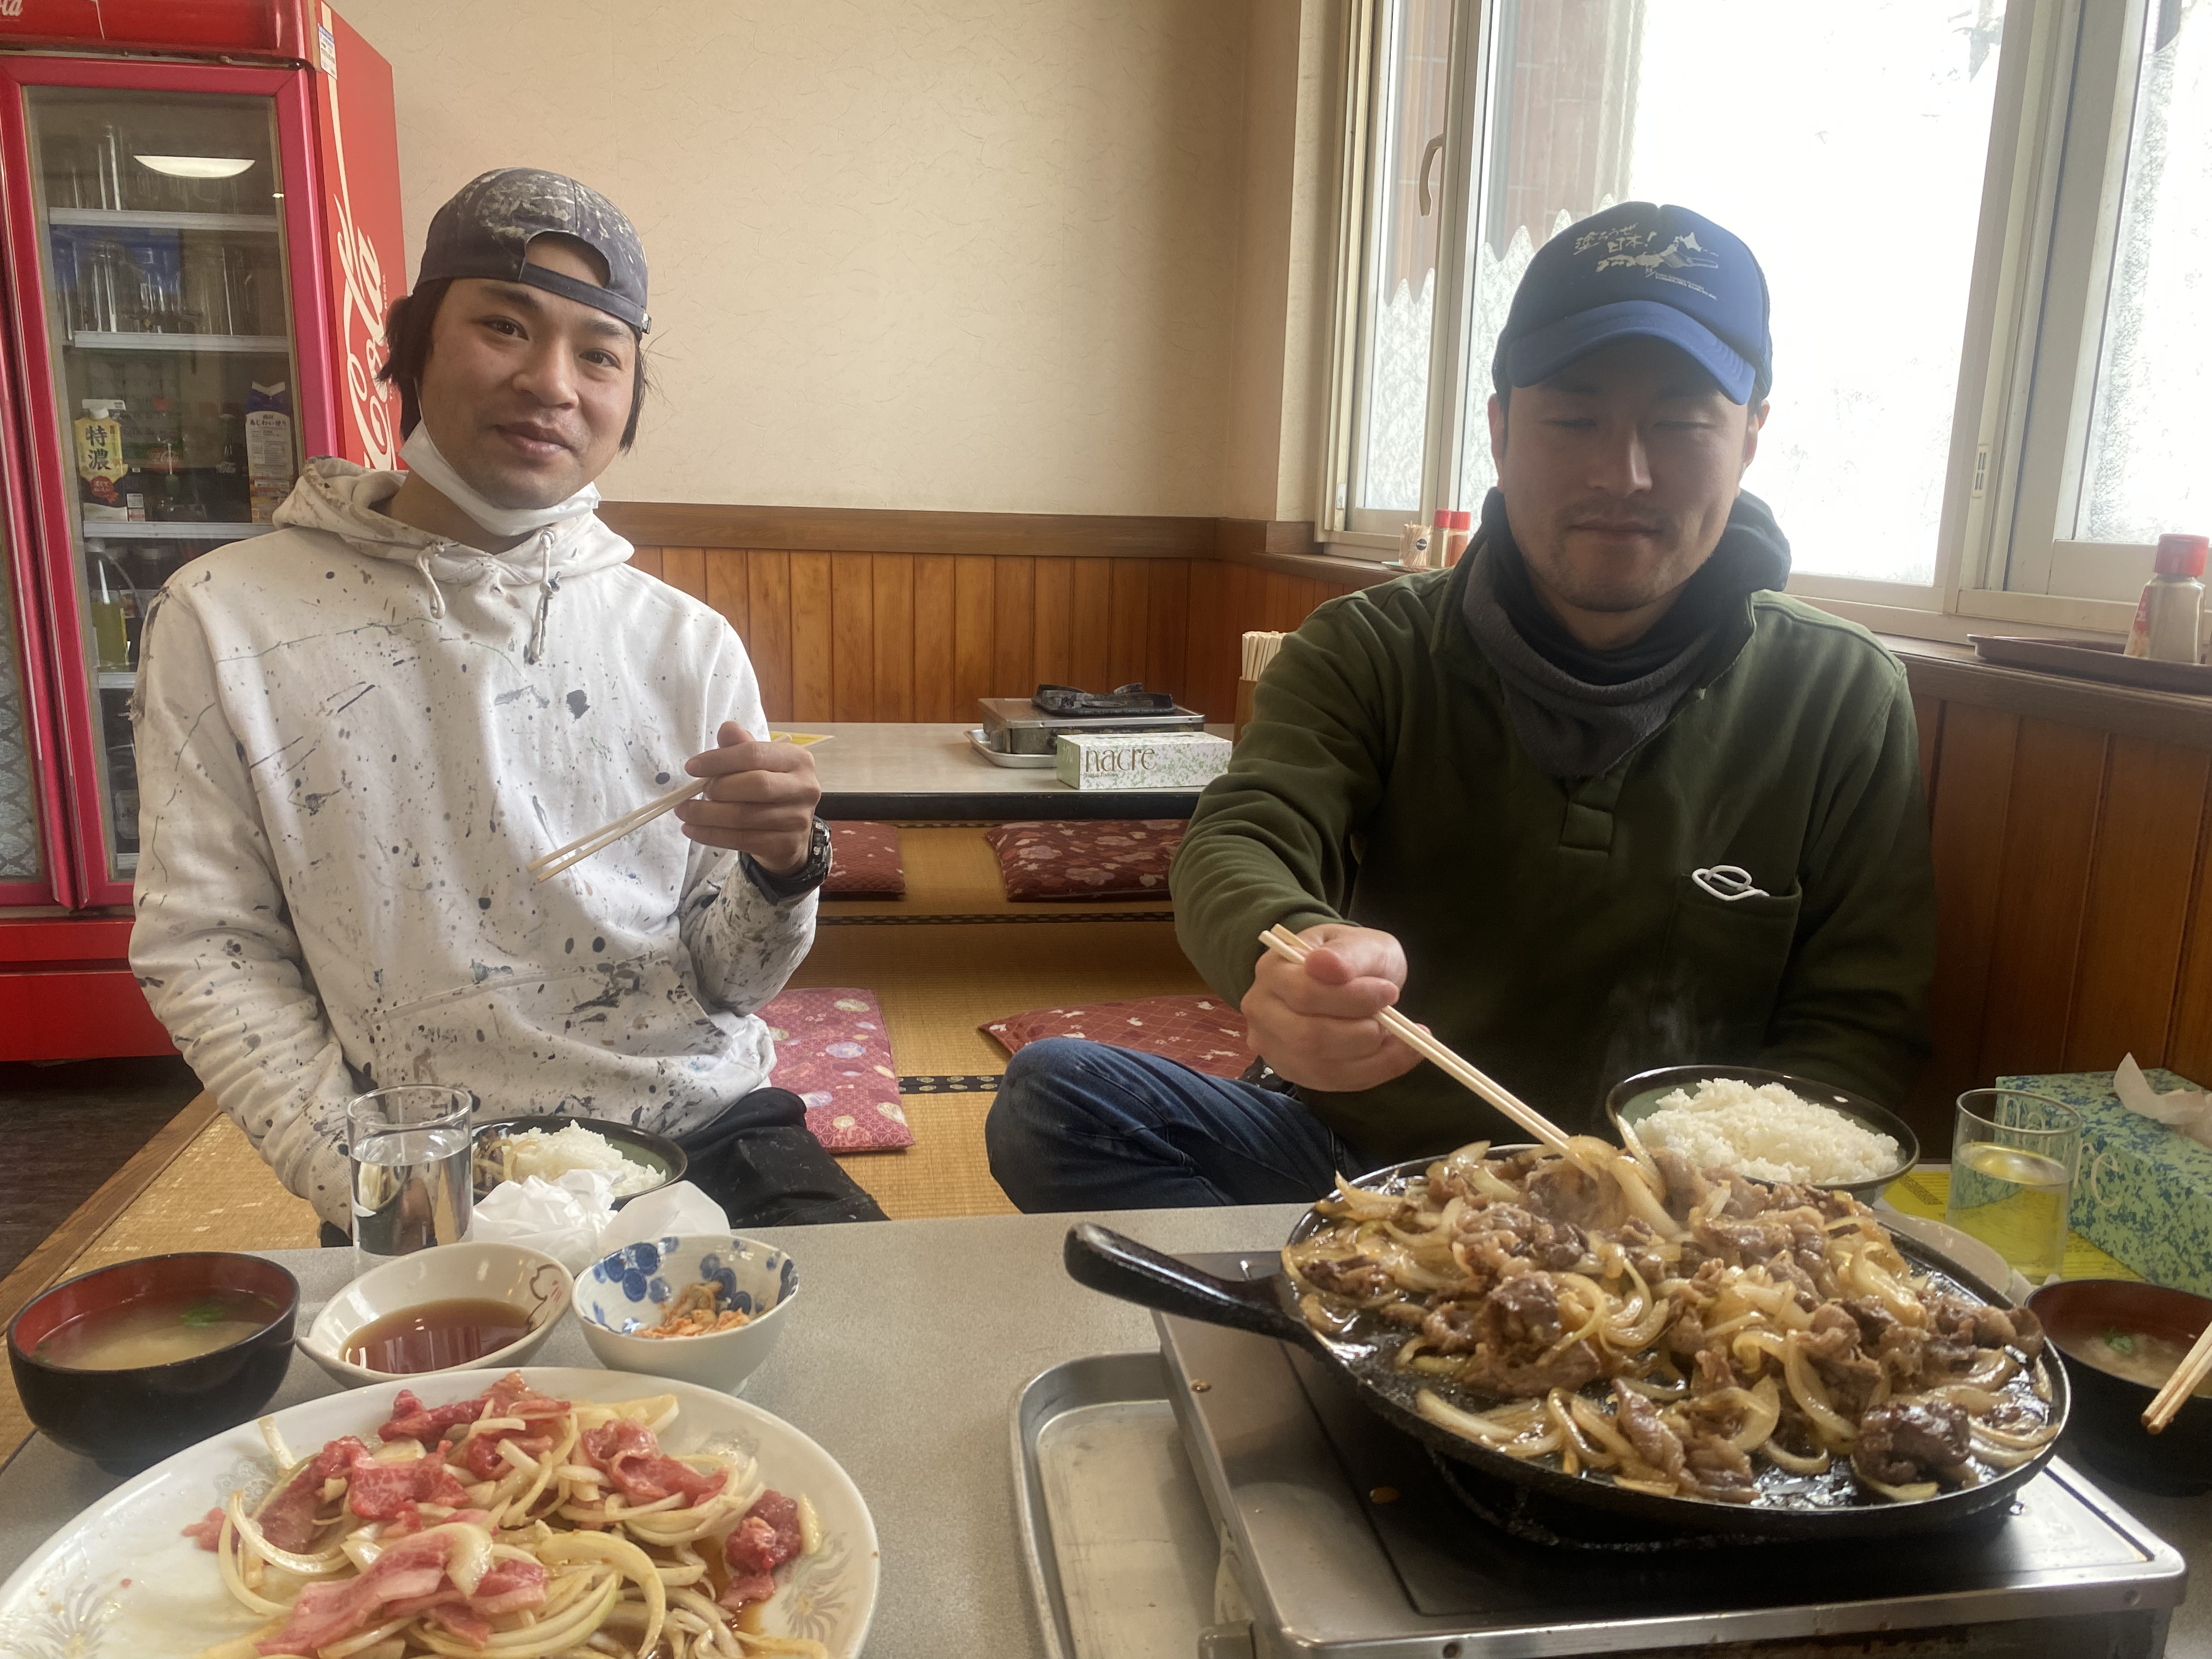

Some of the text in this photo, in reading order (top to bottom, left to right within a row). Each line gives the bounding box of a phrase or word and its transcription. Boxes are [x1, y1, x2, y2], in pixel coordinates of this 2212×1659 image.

[1573, 222, 1639, 255] 塗ろうぜ
[85, 425, 111, 471] 特濃
[1086, 748, 1155, 772] nacre
